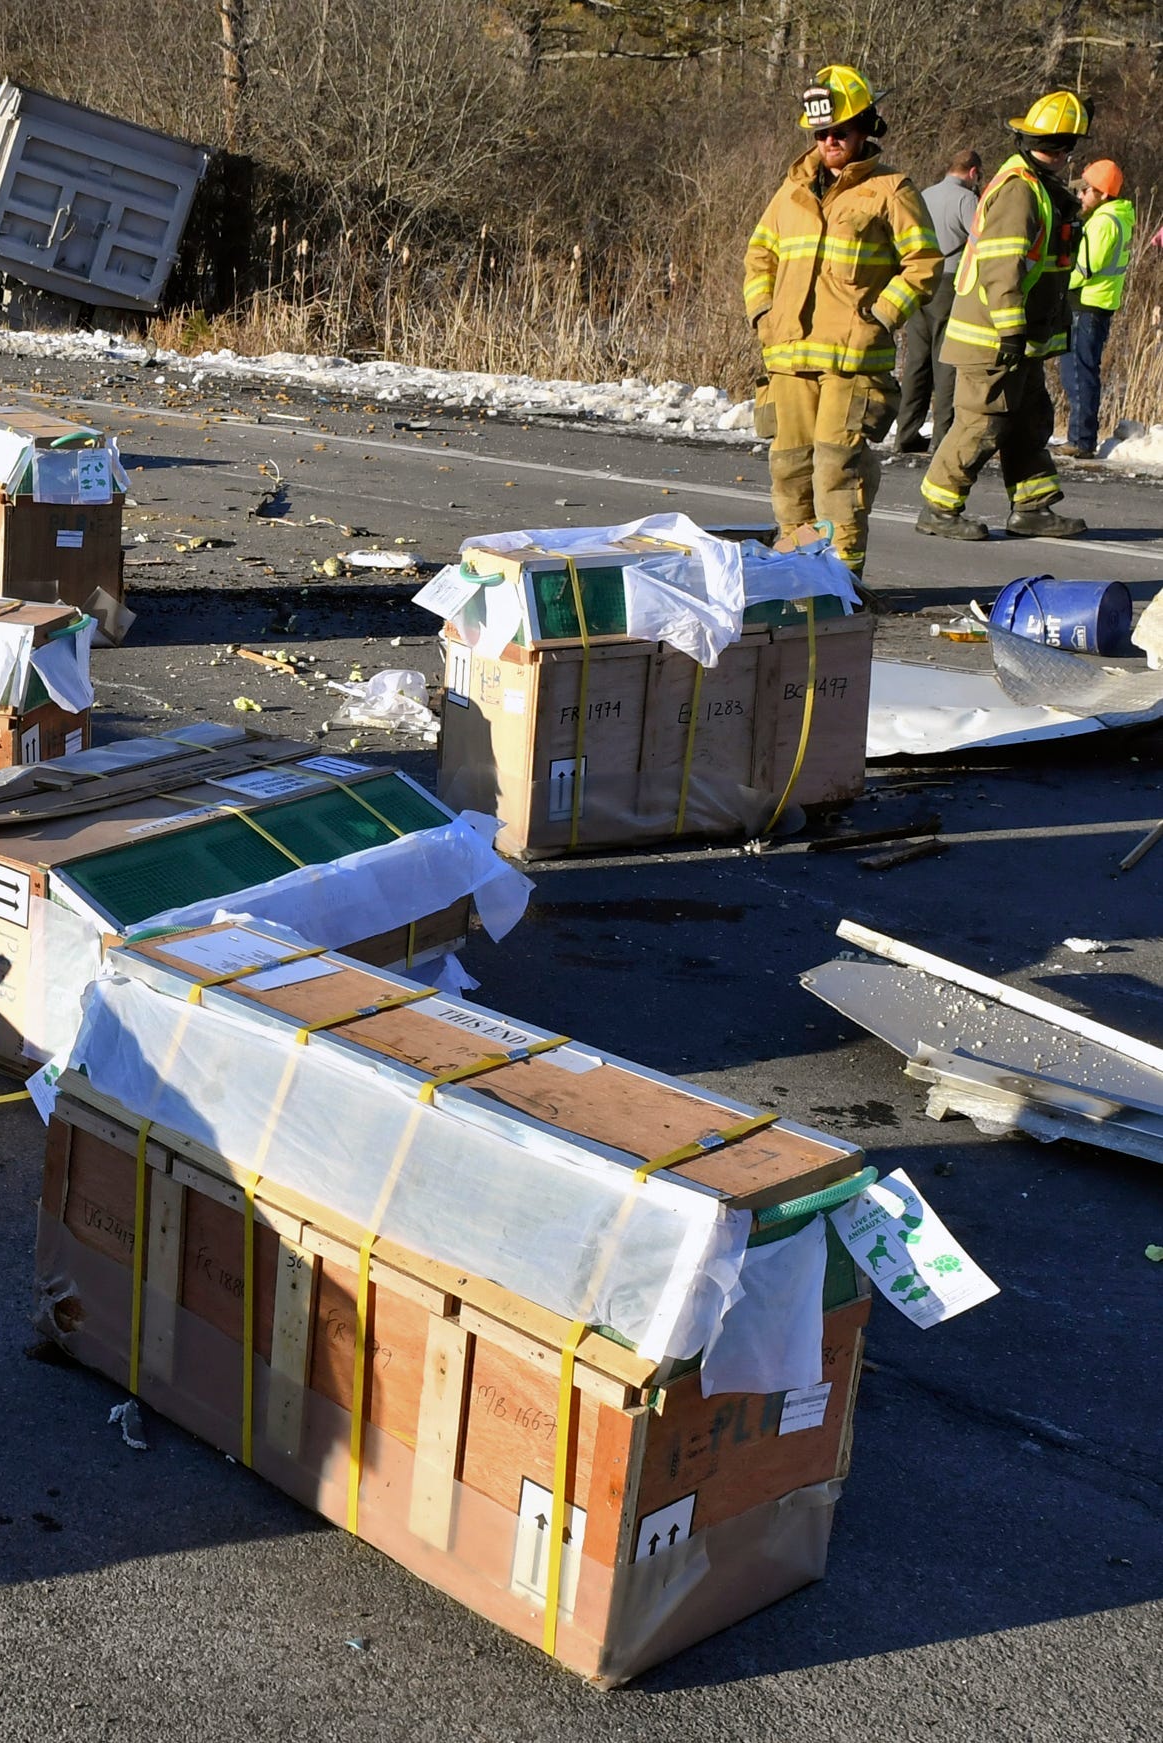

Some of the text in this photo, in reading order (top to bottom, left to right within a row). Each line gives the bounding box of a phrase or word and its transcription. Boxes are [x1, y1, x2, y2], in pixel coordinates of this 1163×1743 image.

[804, 99, 832, 117] 100
[1046, 614, 1062, 647] GHT
[813, 677, 848, 698] 1497
[588, 701, 621, 720] 1974
[707, 699, 744, 721] 1283
[438, 1007, 529, 1047] THIS END
[847, 1216, 881, 1242] ANIMAUX
[850, 1215, 870, 1230] LIVE
[475, 1384, 558, 1440] MB 1667
